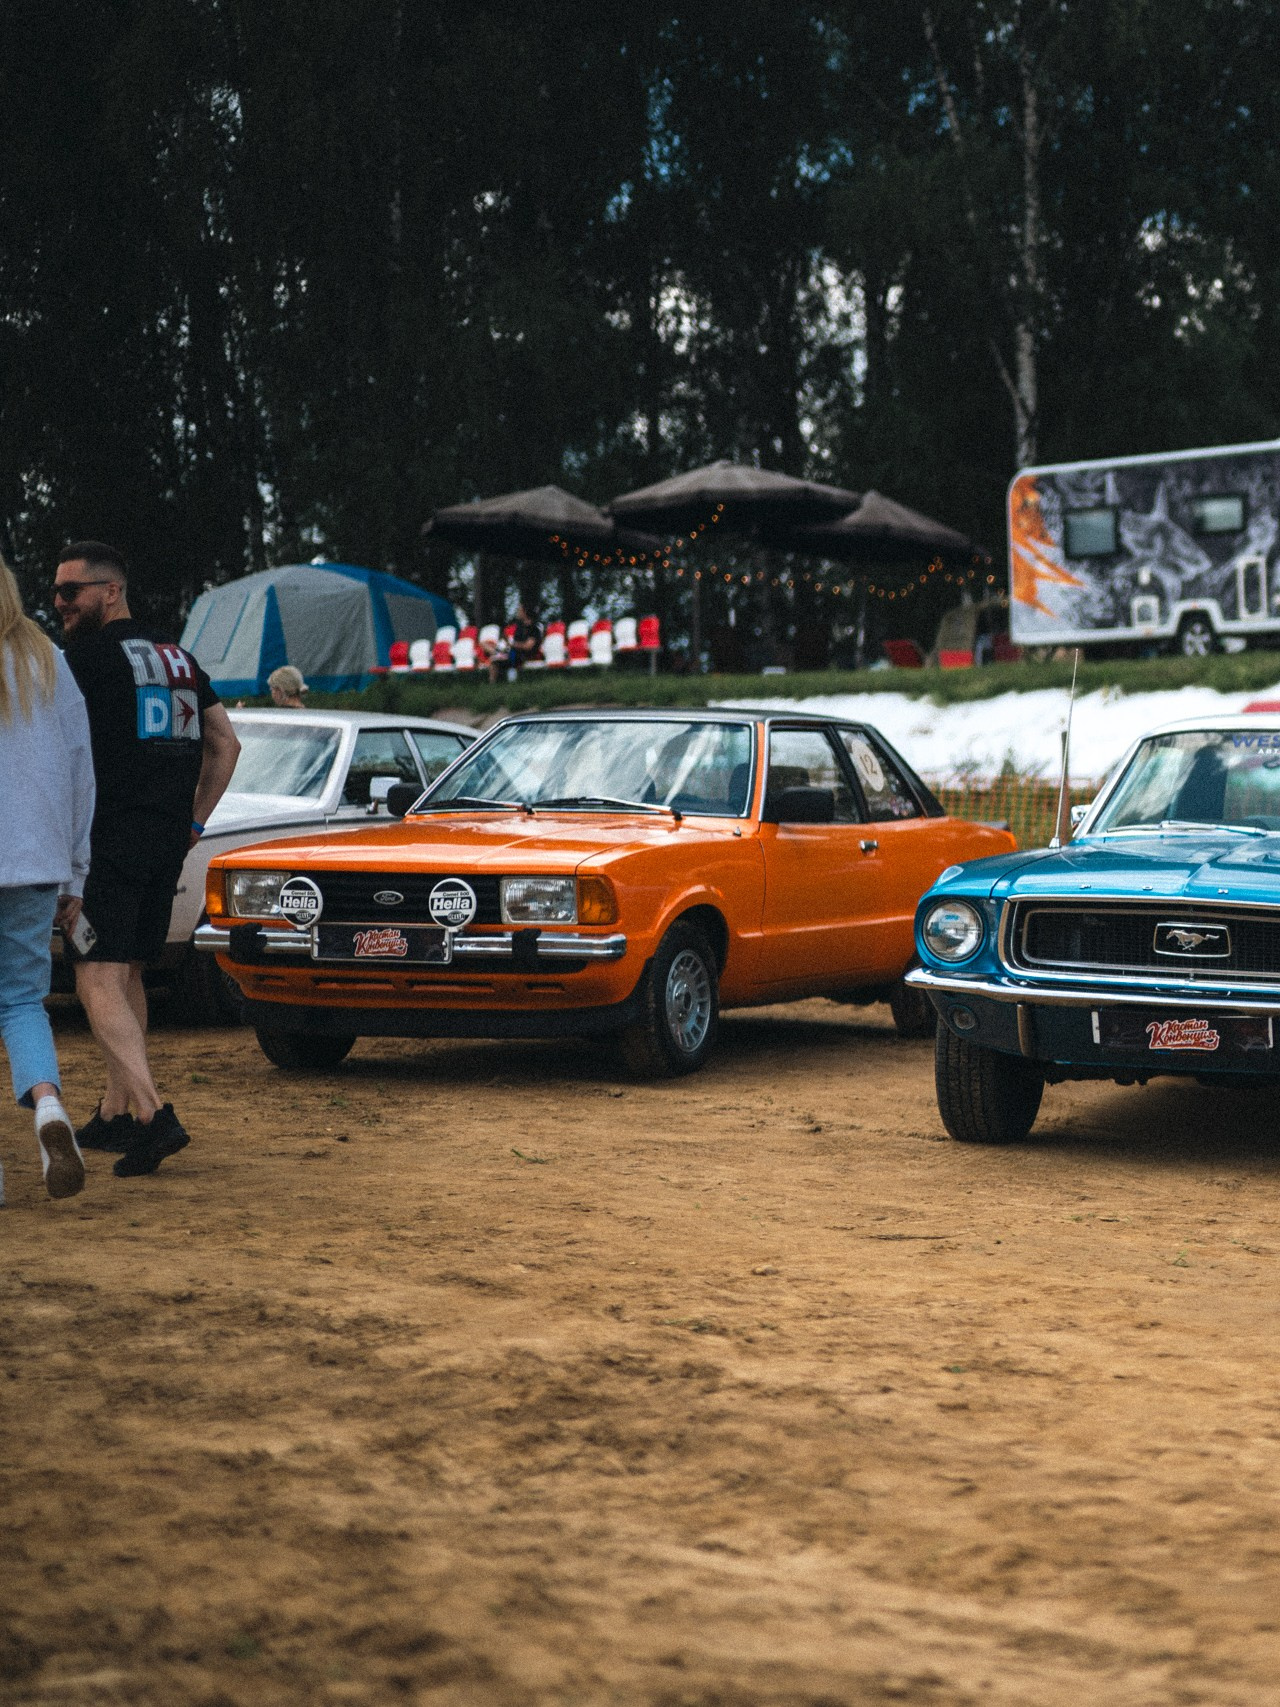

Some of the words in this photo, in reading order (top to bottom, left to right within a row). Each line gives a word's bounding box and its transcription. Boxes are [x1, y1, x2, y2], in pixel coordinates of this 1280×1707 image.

[144, 697, 169, 733] D
[282, 896, 317, 909] Hella
[432, 897, 471, 910] Hella
[1163, 1019, 1208, 1032] Кастом
[1146, 1022, 1219, 1049] Конвенция
